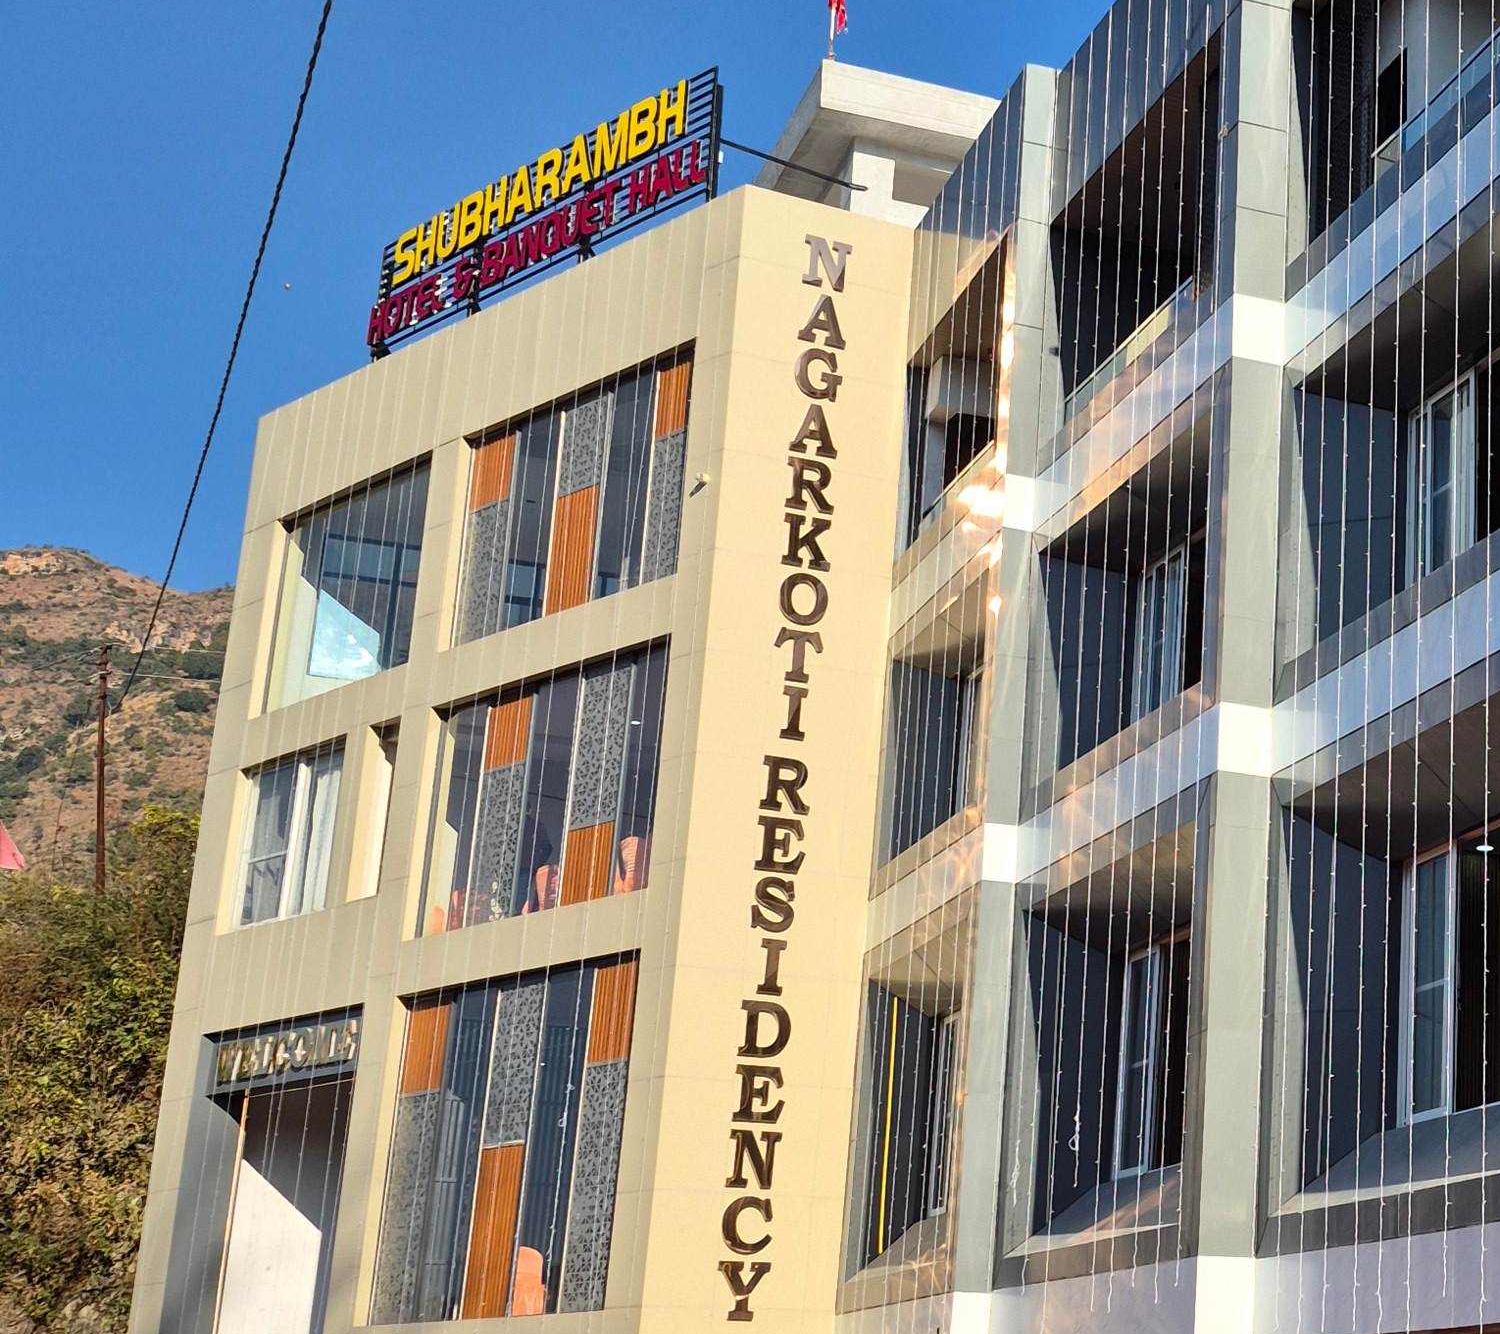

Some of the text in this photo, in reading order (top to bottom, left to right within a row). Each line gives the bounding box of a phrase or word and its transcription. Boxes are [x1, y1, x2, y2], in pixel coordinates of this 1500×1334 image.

[367, 139, 707, 346] HOTEL & BANQUET HALL
[392, 79, 690, 286] SHUBHARAMBH
[717, 233, 853, 1323] NAGARKOTI RESIDENCY
